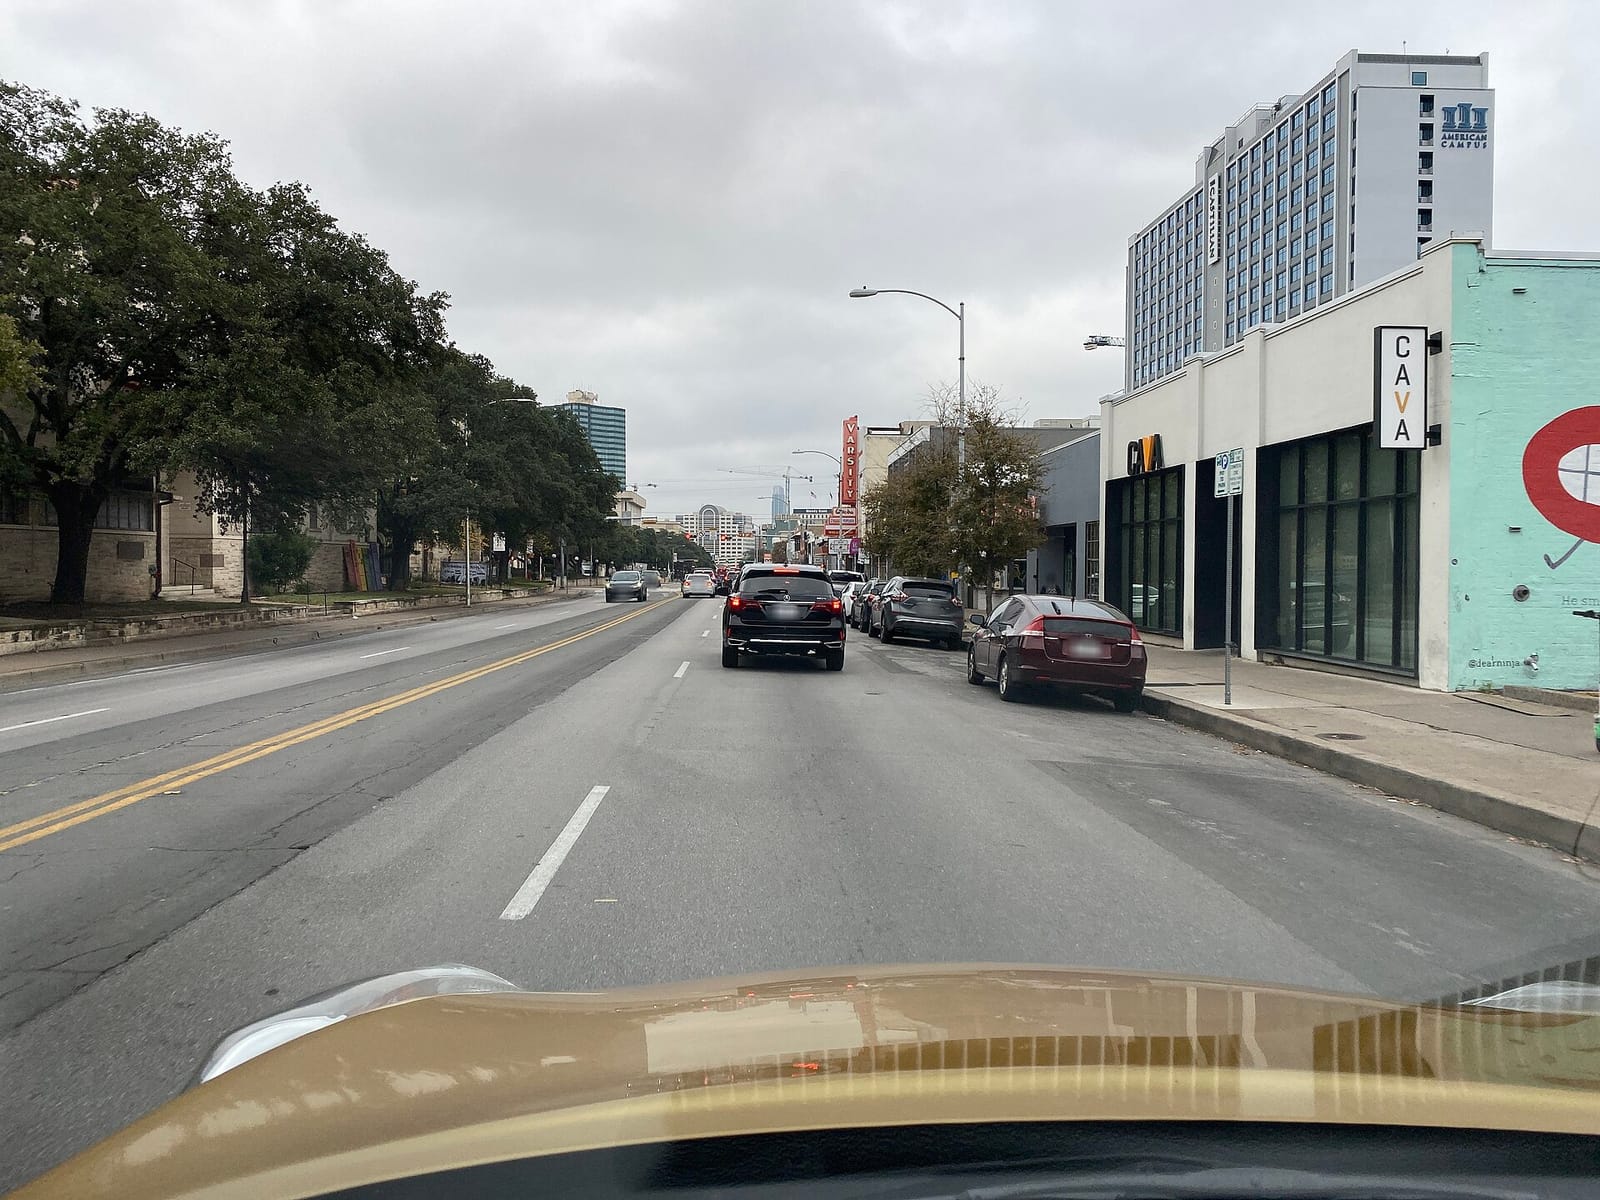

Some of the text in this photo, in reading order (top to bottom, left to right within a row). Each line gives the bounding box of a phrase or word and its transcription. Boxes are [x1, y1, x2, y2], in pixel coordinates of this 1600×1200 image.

[1441, 133, 1488, 141] AMERICAN
[1441, 141, 1488, 149] CAMPUS
[1394, 335, 1411, 441] CAVA
[1127, 433, 1165, 476] CAVA
[846, 423, 856, 498] VARSITY
[1561, 595, 1578, 606] He
[1468, 658, 1521, 668] @dearninja
